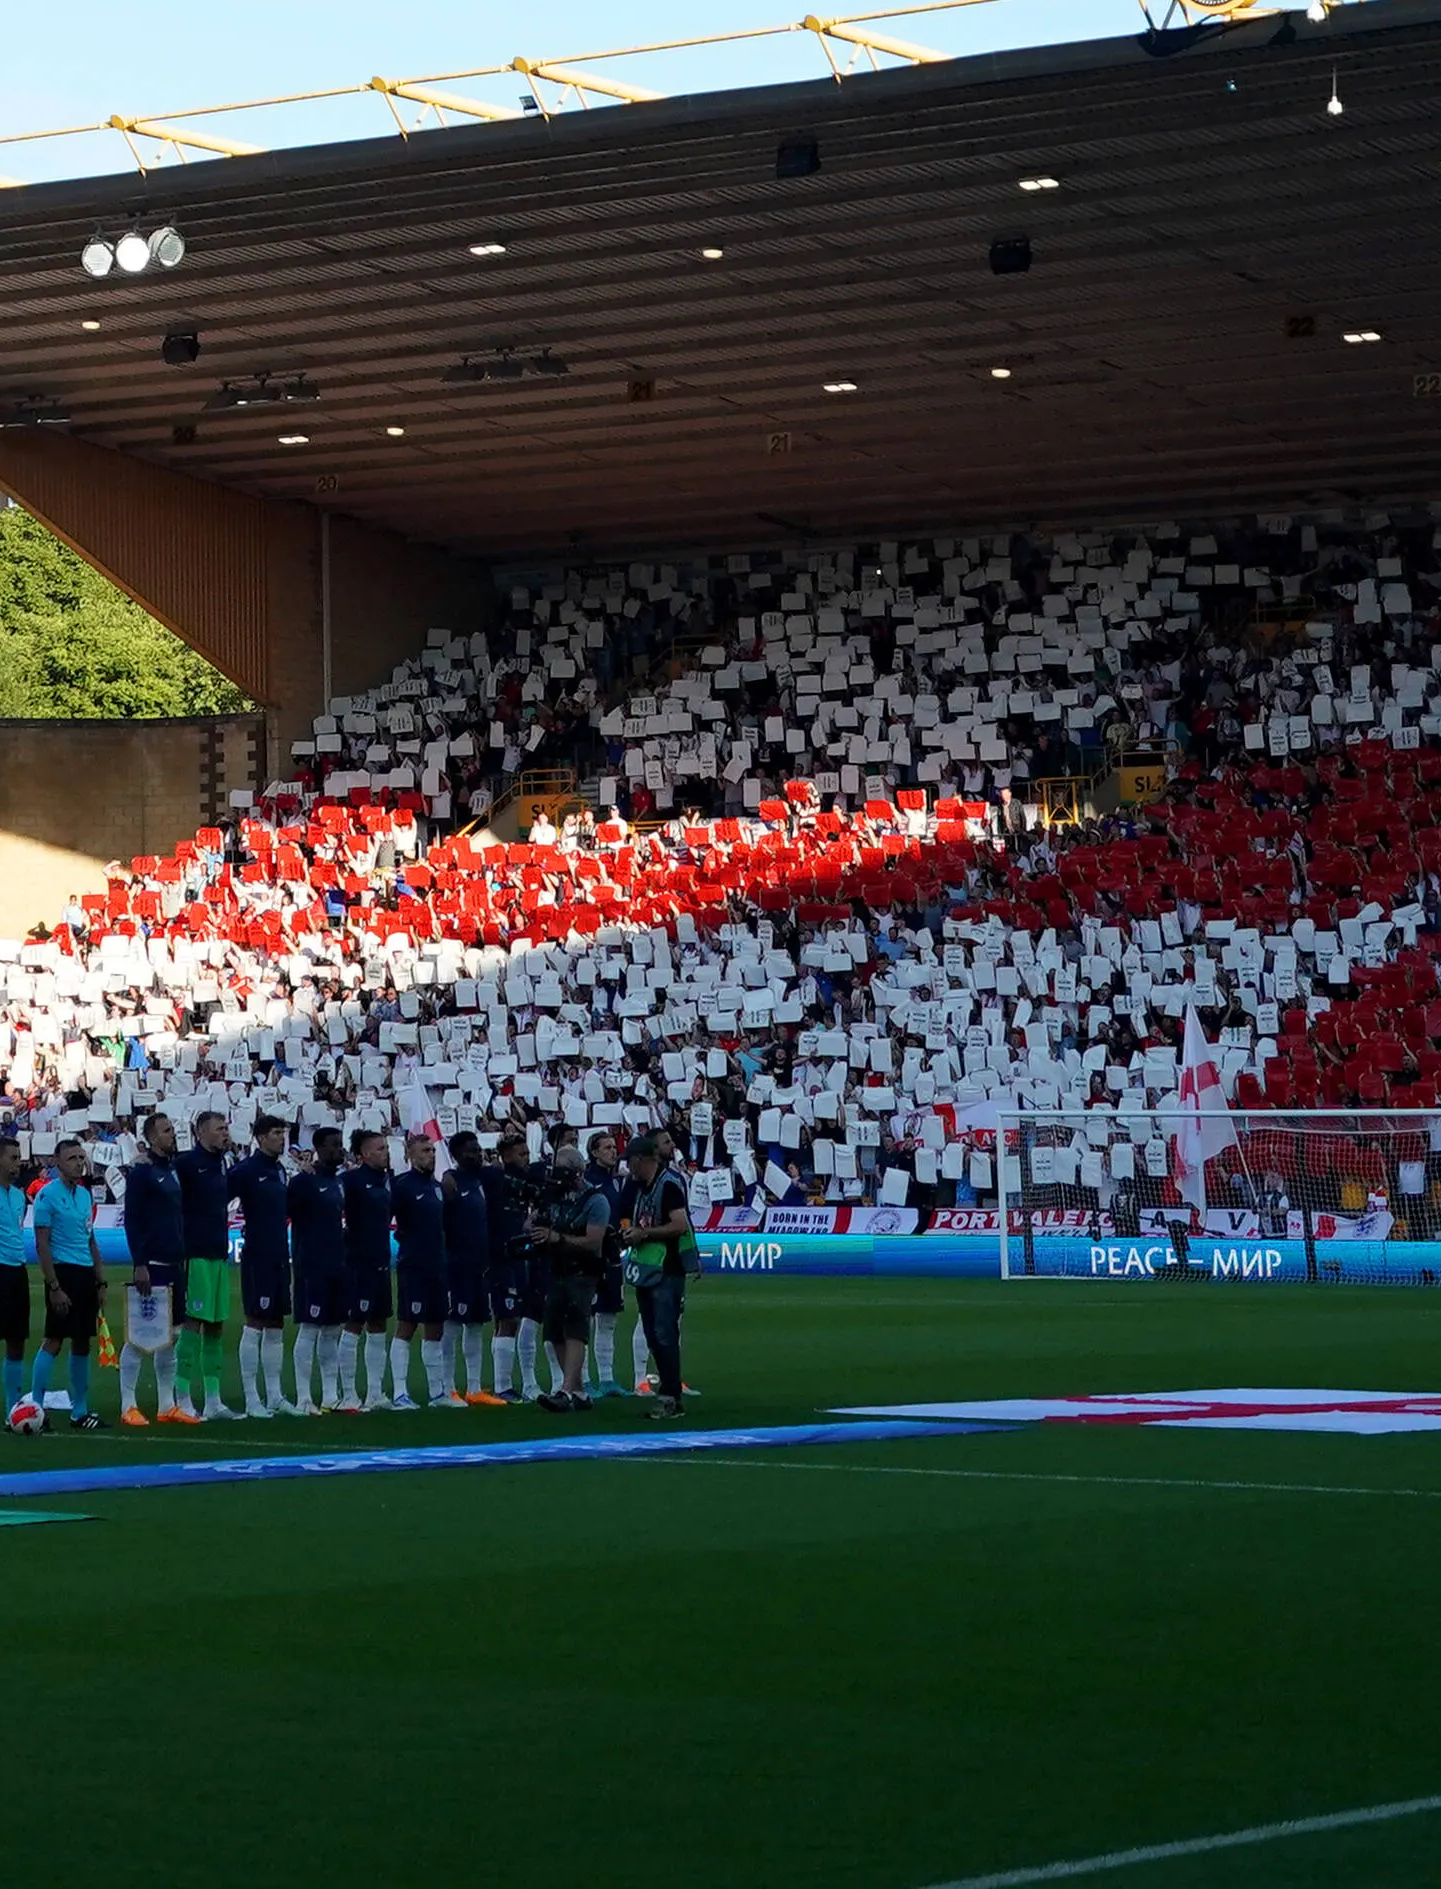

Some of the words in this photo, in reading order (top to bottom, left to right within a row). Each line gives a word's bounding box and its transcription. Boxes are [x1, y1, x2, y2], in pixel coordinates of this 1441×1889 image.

[933, 1211, 1000, 1229] PORT
[720, 1243, 783, 1270] МИР
[1212, 1249, 1283, 1279] МИР
